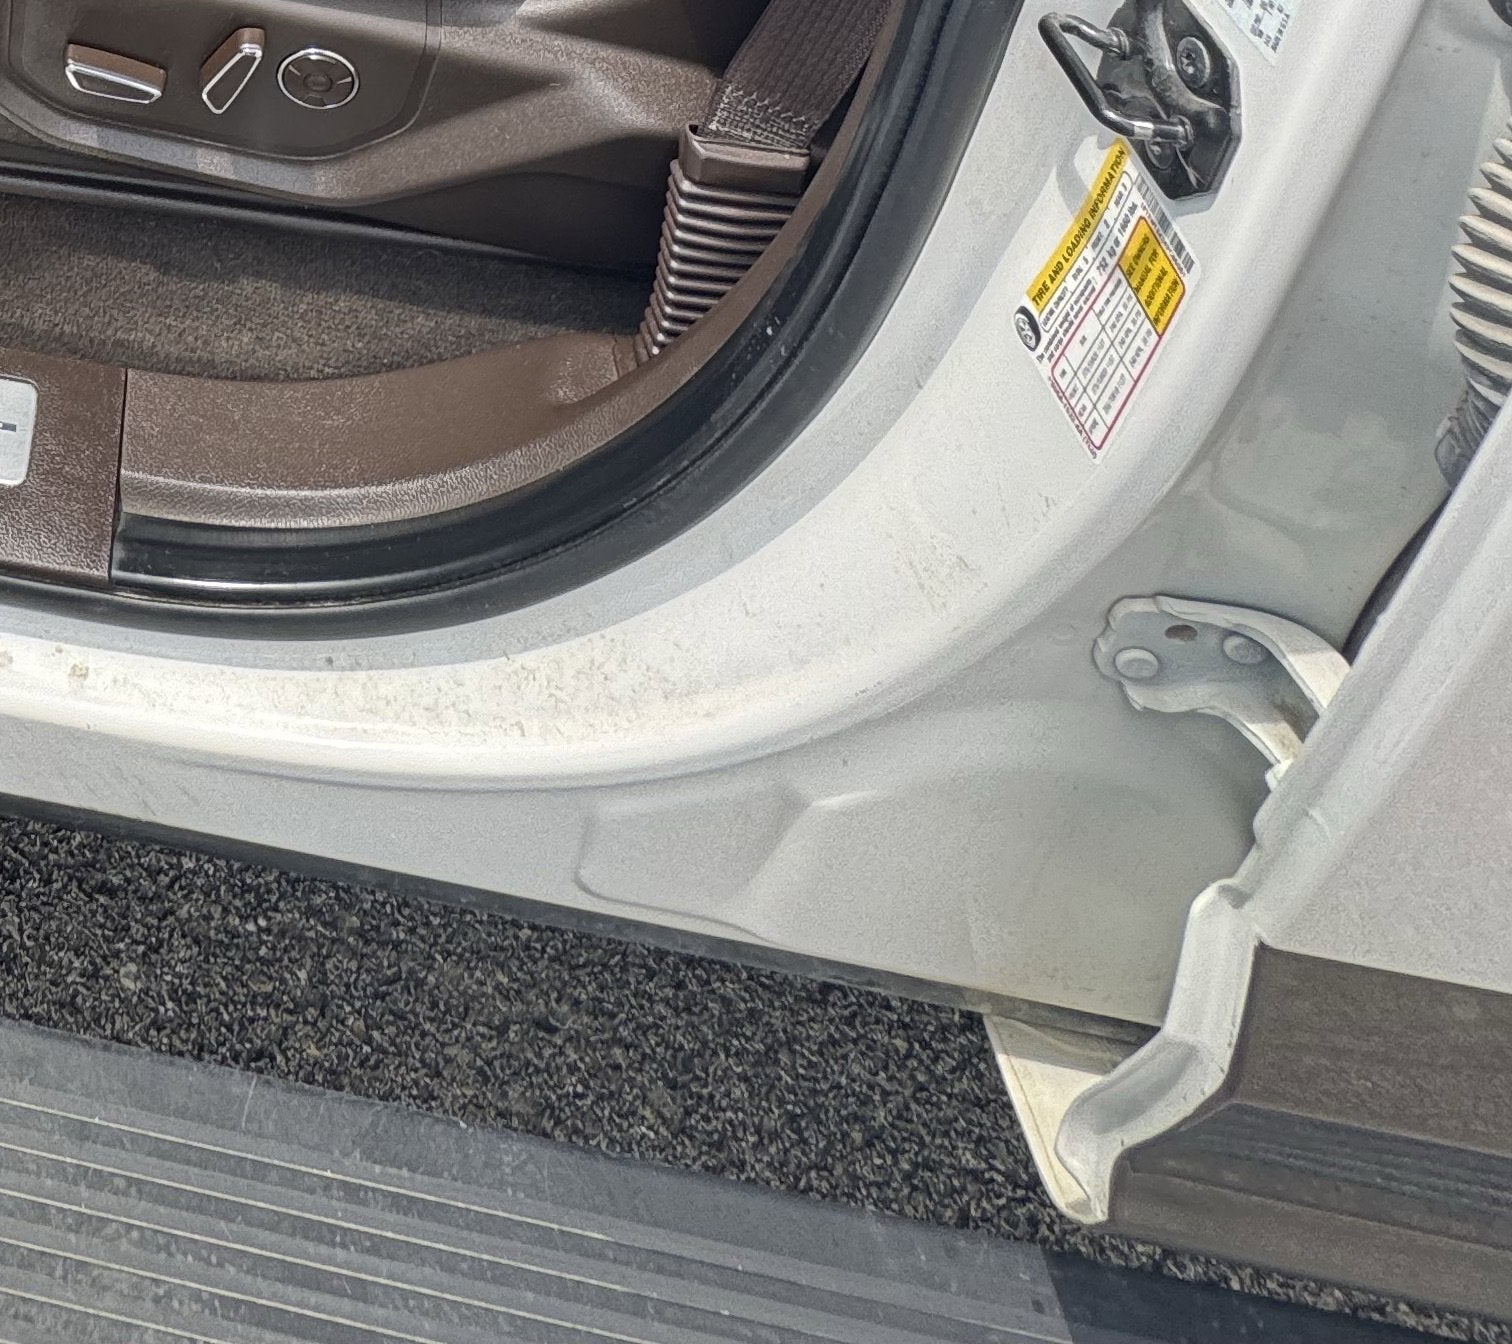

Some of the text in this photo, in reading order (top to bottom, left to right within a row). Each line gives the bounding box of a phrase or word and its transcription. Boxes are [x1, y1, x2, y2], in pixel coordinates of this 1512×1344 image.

[1031, 279, 1050, 308] TIRE
[1046, 257, 1064, 285] AND
[1061, 214, 1092, 263] LOADING
[1090, 148, 1126, 219] INFORMATION
